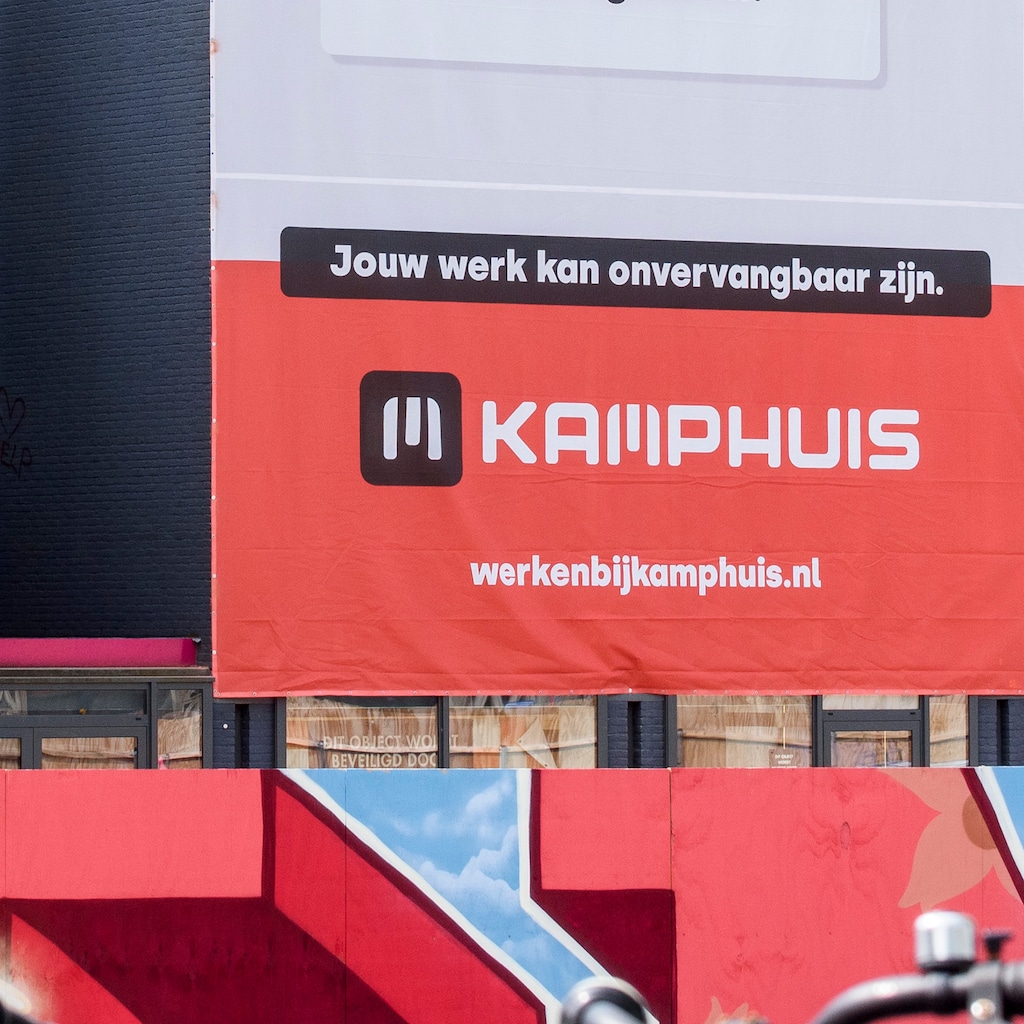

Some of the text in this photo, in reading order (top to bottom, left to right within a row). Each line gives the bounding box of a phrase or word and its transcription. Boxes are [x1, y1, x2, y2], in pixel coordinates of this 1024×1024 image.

[330, 244, 944, 304] Jouw werk kan onvervangbaar zijn.
[482, 400, 920, 471] KAMPHUIS
[470, 554, 822, 596] werkenbijkamphuis.nl
[323, 734, 459, 750] DIT OBJECT WOT
[332, 753, 438, 768] BEVEILIGD DOO
